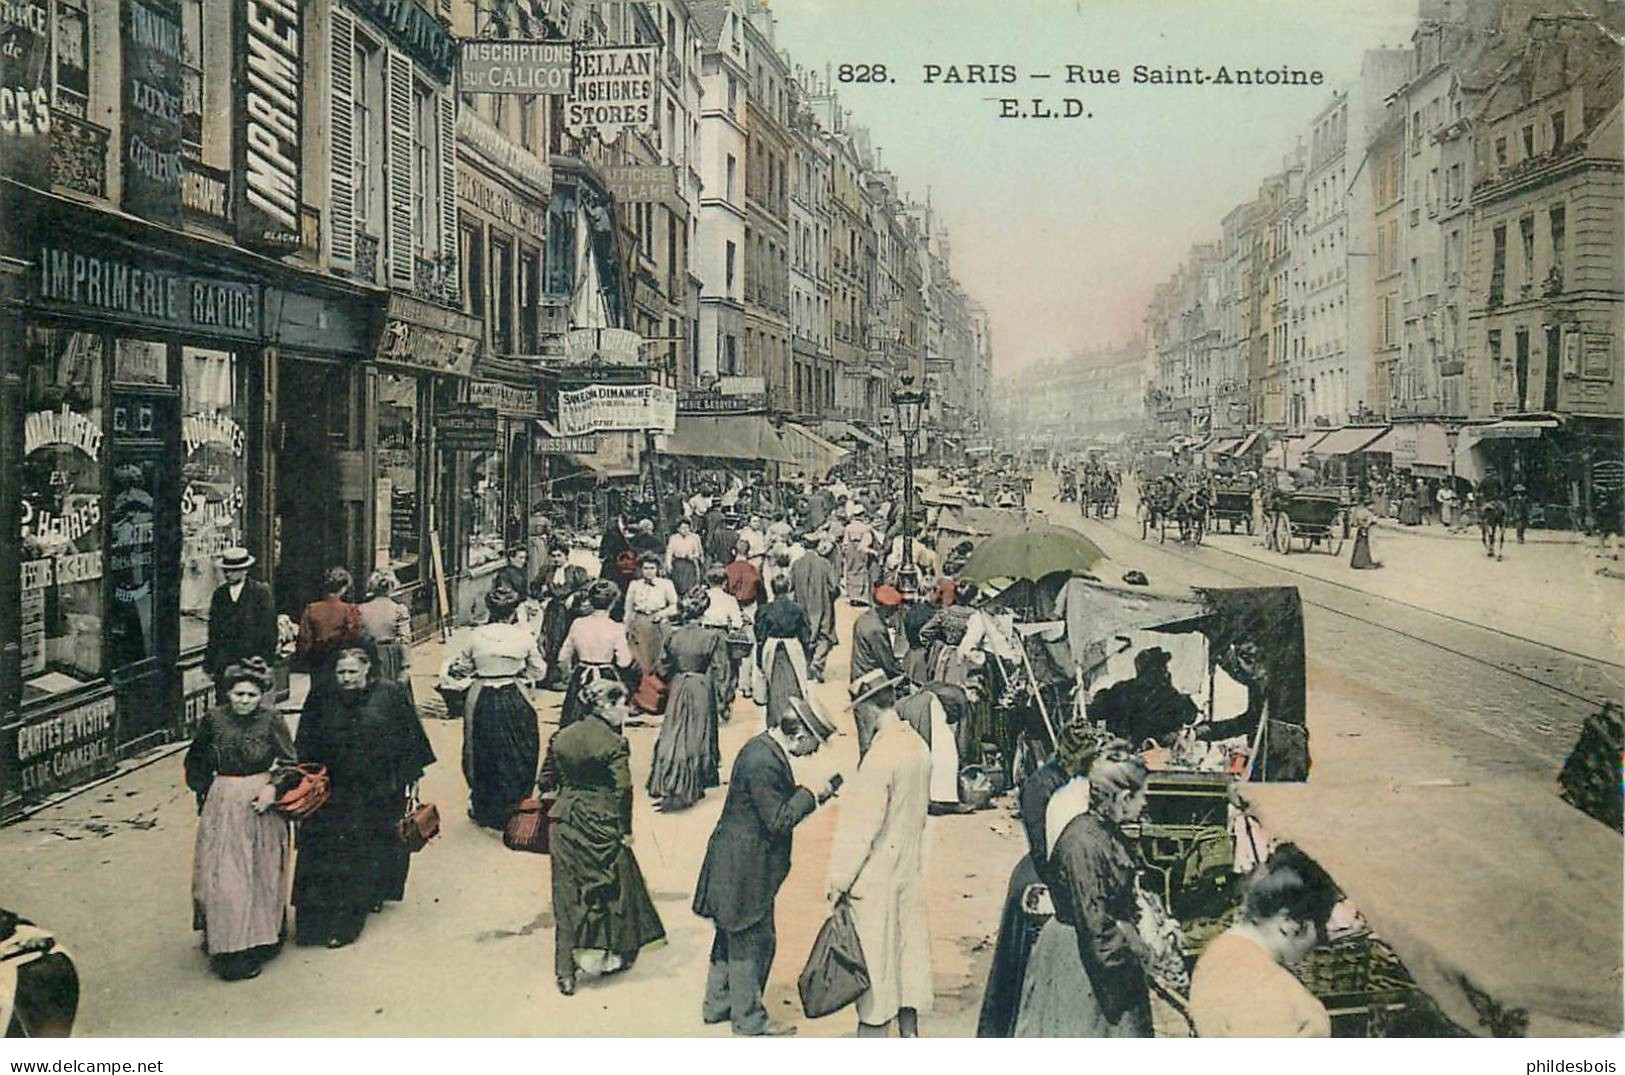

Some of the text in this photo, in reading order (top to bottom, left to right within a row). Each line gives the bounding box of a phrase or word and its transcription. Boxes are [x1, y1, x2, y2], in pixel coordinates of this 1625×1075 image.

[463, 43, 572, 62] INSCRIPTIONS
[573, 52, 650, 77] BELLAN
[463, 66, 571, 89] sur CALICOT
[132, 79, 180, 124] LUXE
[570, 104, 648, 125] STORES
[40, 247, 252, 328] IMPRIMERIE RAPIDE
[599, 387, 652, 399] DIMANCHE
[38, 498, 100, 540] HEURES
